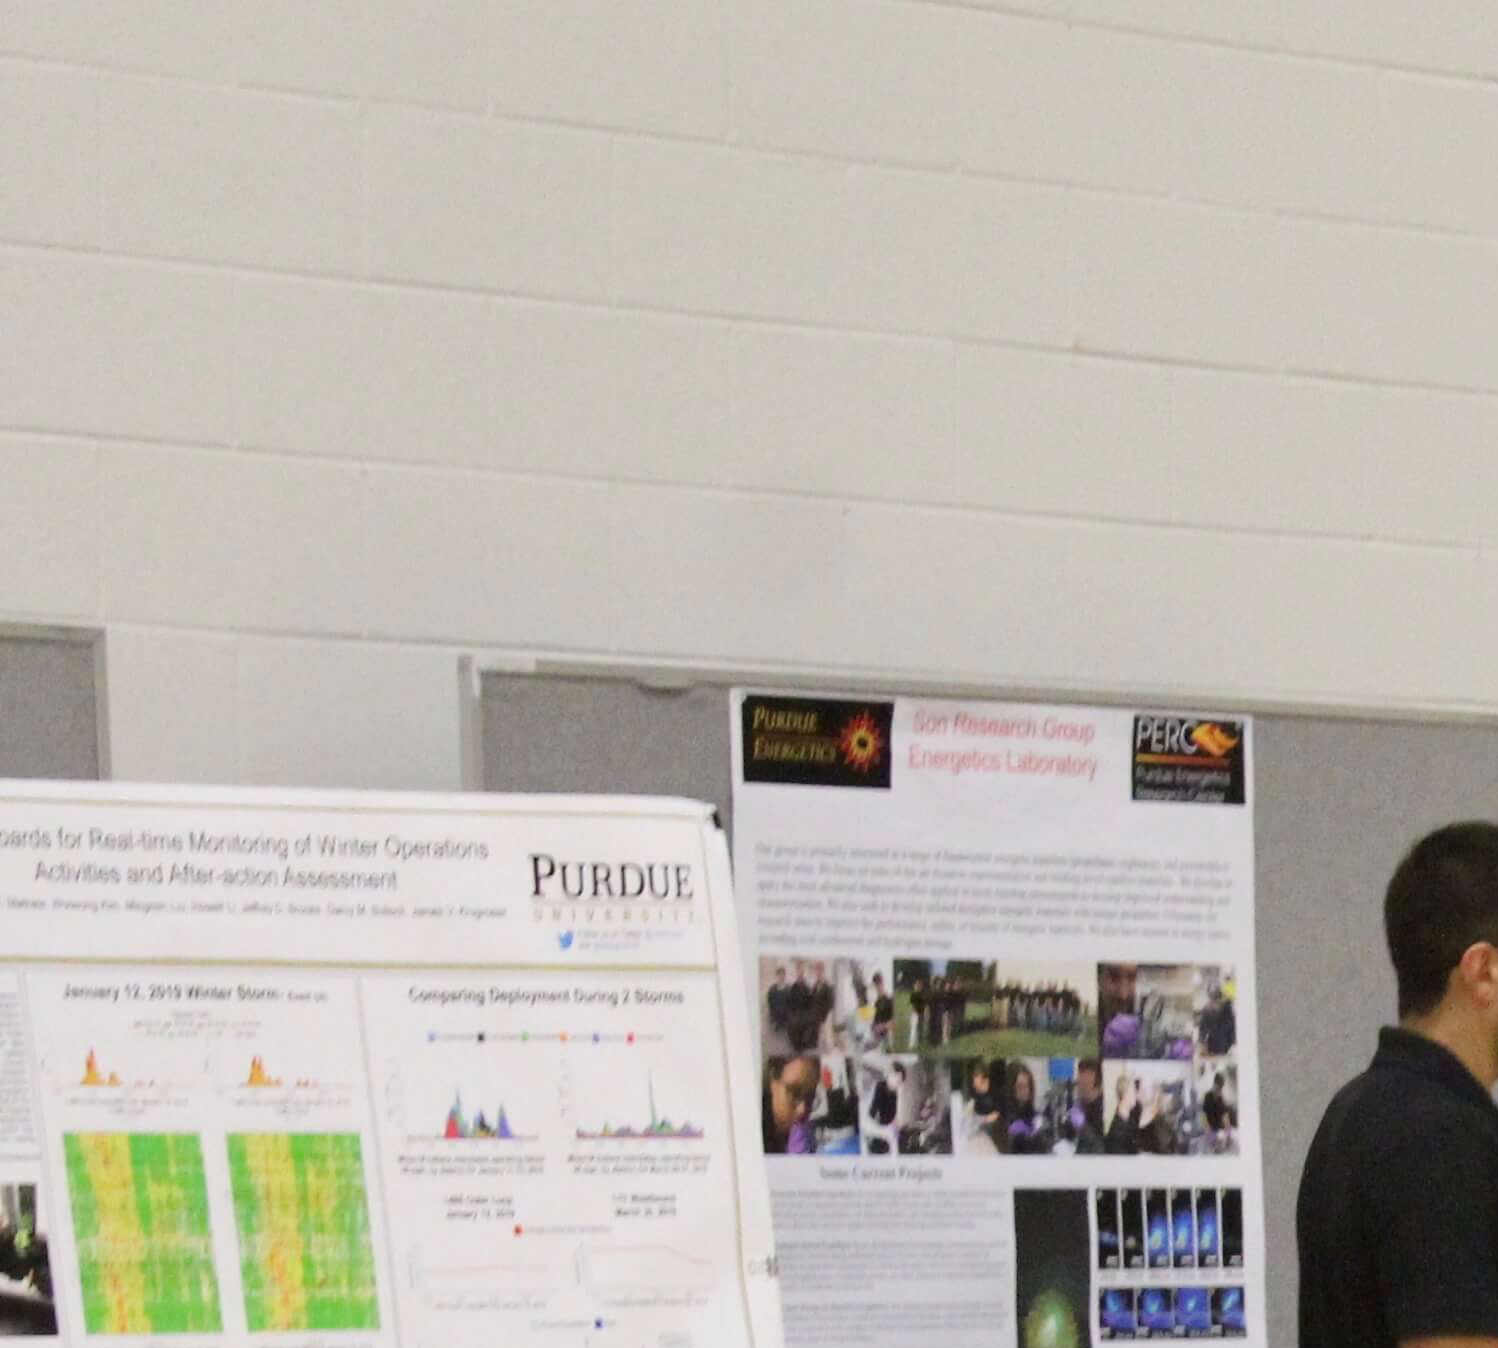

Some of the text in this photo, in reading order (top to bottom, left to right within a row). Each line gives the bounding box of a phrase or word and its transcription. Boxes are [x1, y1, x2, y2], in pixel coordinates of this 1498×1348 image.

[954, 711, 1037, 738] Research
[1042, 716, 1096, 746] Group
[1136, 717, 1199, 754] PERC
[909, 744, 1097, 782] Energetics Laboratory
[57, 826, 82, 849] for
[89, 827, 182, 851] Real-time
[189, 831, 288, 858] Monitoring
[295, 834, 312, 855] of
[318, 834, 378, 858] Winter
[385, 834, 490, 861] Operations
[35, 861, 397, 891] Activities and After-action Assessment
[529, 853, 694, 900] PURDUE
